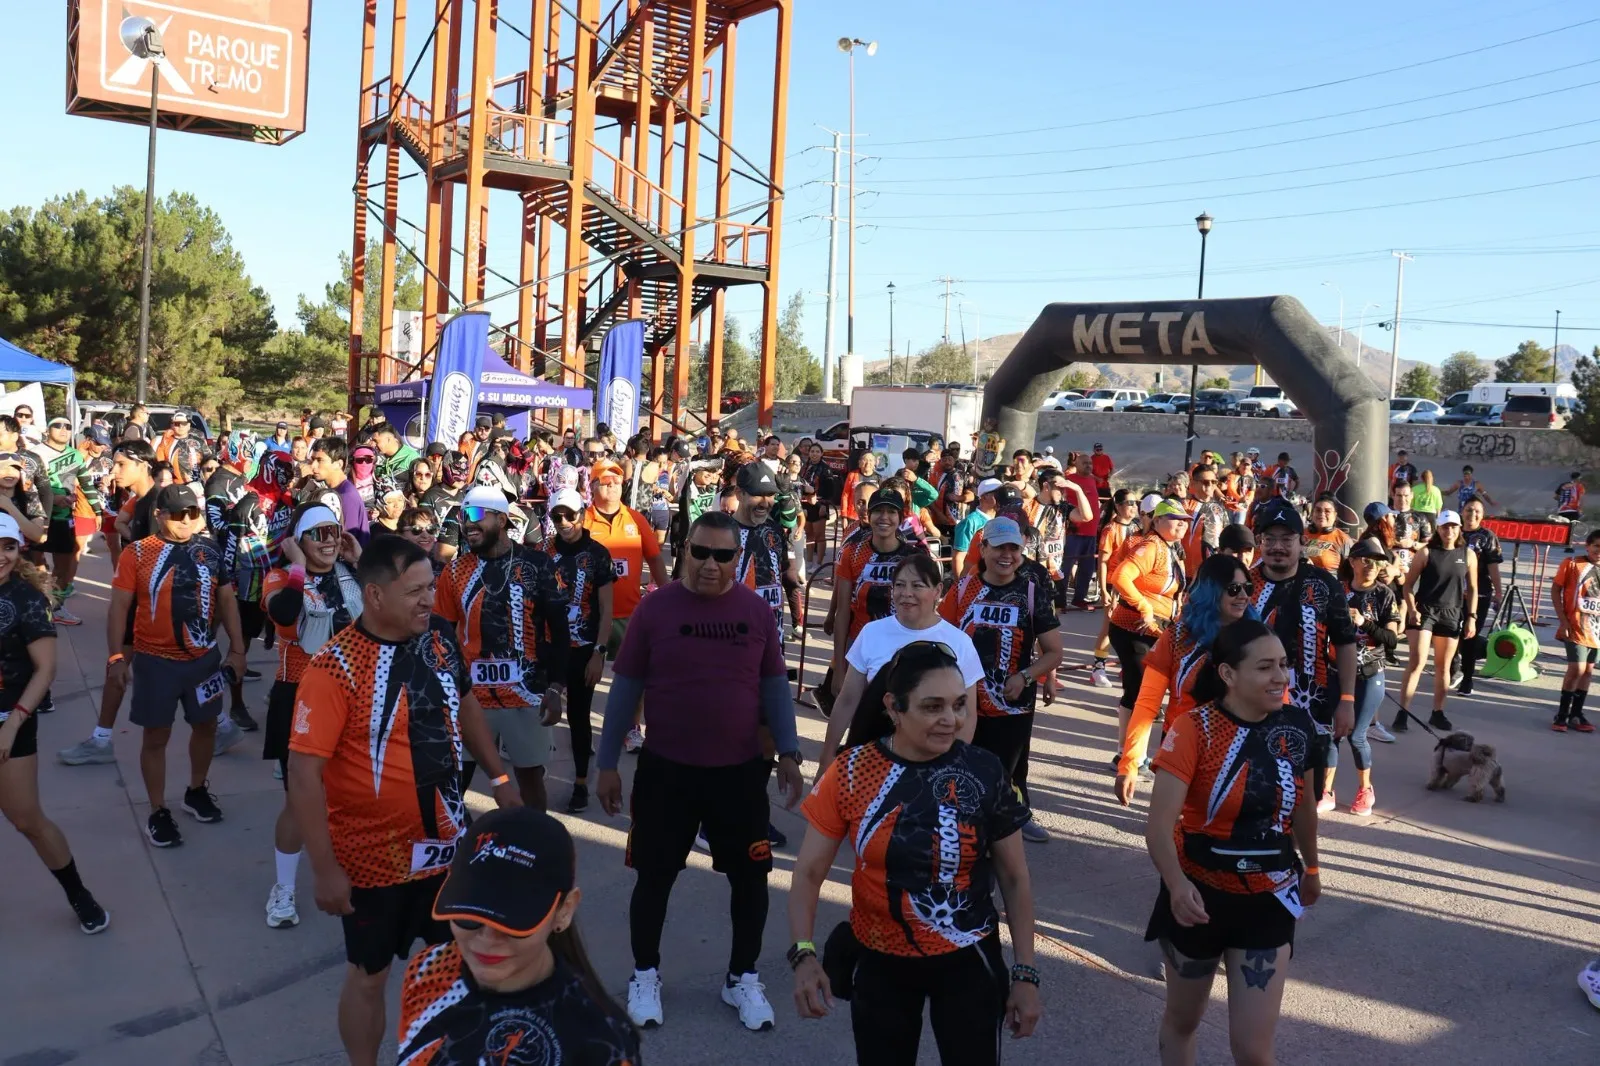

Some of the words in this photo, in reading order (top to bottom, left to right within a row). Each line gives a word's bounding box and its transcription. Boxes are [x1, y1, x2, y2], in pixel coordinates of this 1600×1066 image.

[188, 30, 280, 70] PARQUE
[1072, 311, 1218, 355] META
[488, 392, 500, 401] SU
[502, 393, 532, 404] MEJOR
[534, 395, 568, 407] OPCIÓN
[507, 583, 524, 652] ESCLERÓSIS
[980, 606, 1011, 624] 446
[999, 628, 1013, 671] ESCLERÓ
[1298, 605, 1316, 675] ESCLERÓSIS
[202, 677, 225, 698] 331
[477, 663, 511, 682] 300
